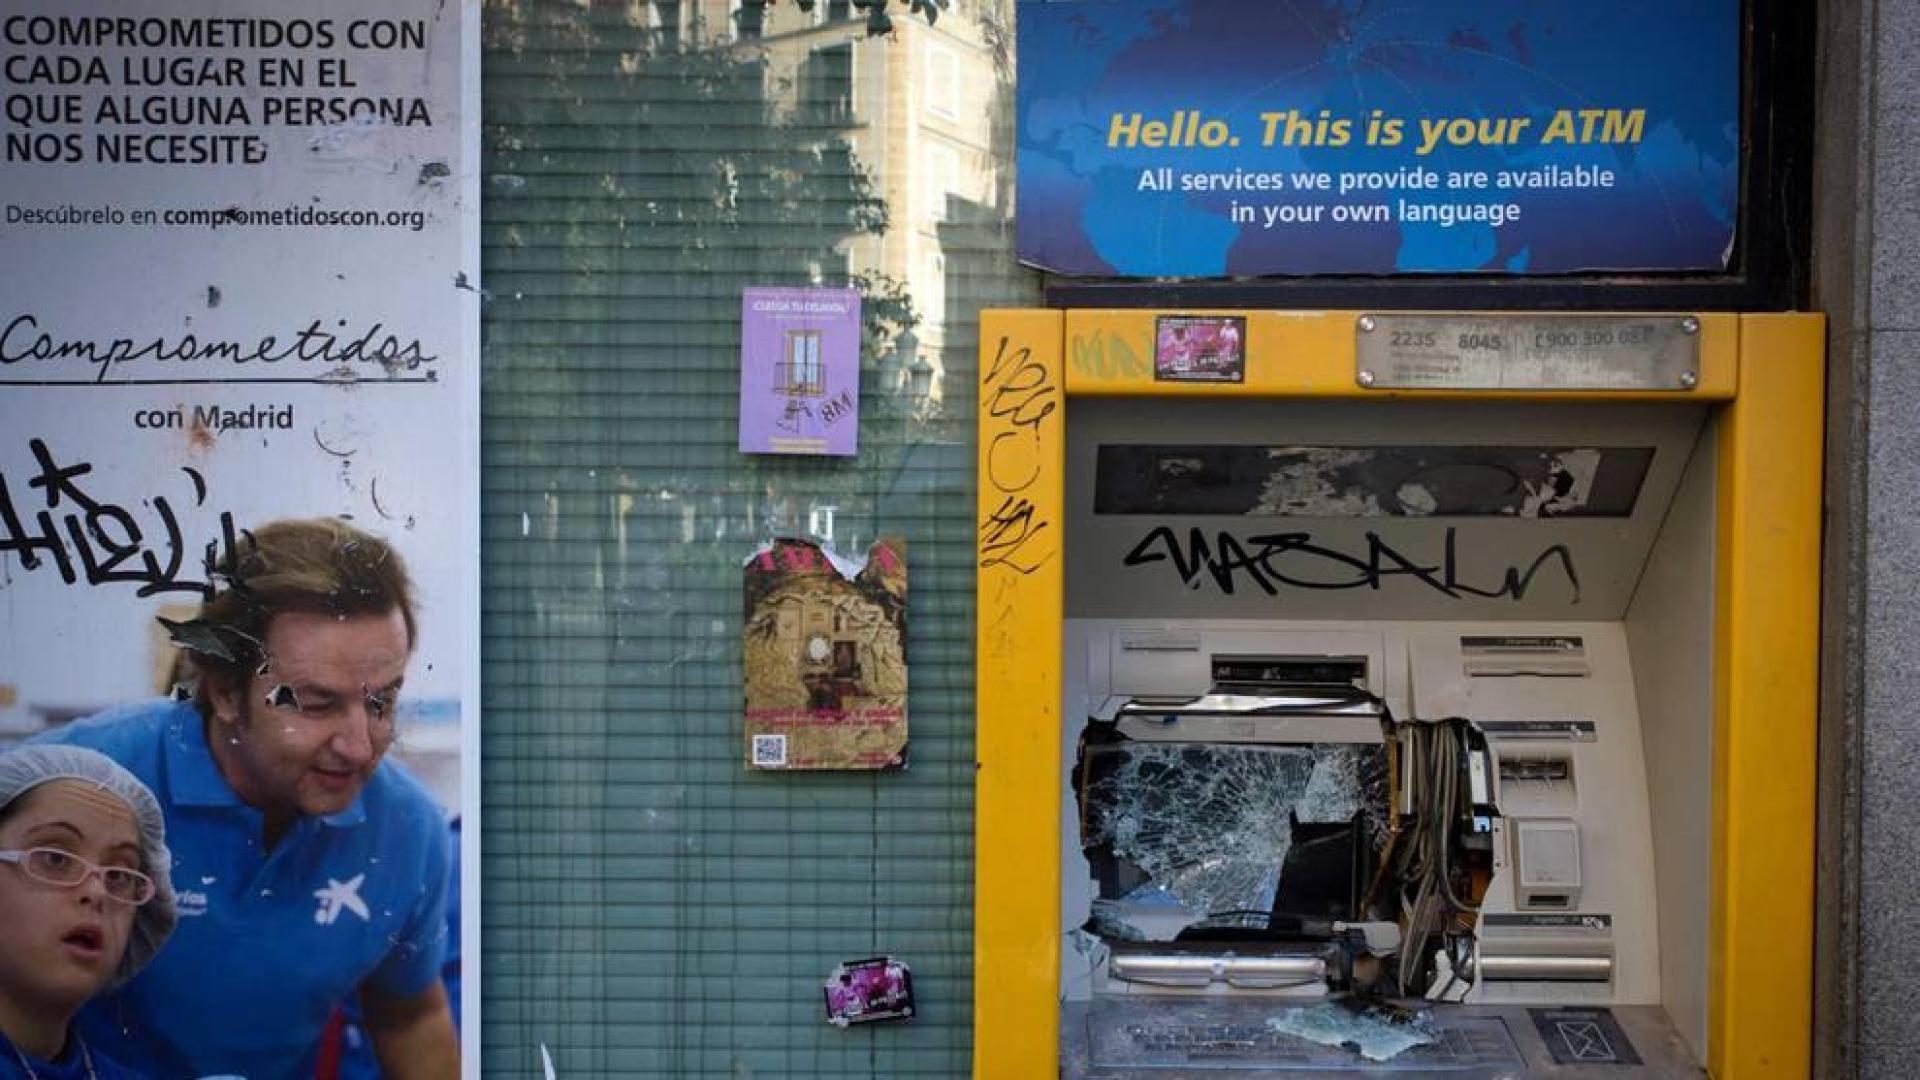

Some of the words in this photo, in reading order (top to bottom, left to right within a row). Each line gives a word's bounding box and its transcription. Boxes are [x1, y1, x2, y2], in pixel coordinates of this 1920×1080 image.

[4, 16, 335, 49] COMPROMETIDOS
[347, 20, 425, 49] CON
[5, 55, 110, 86] CADA
[123, 57, 246, 88] LUGAR
[259, 59, 303, 87] EN
[318, 59, 357, 87] EL
[5, 94, 83, 129] QUE
[95, 95, 251, 126] ALGUNA
[263, 97, 432, 127] PERSONA
[1107, 111, 1241, 148] Hello.
[1260, 110, 1352, 147] This
[1366, 110, 1404, 146] is
[1415, 115, 1530, 155] your
[1541, 109, 1646, 144] ATM
[6, 134, 83, 163] NOS
[97, 136, 268, 164] NECESITE
[1138, 170, 1173, 192] All
[1181, 170, 1283, 191] services
[1292, 174, 1331, 191] we
[1339, 168, 1439, 195] provide
[1447, 171, 1489, 188] are
[1496, 165, 1615, 188] available
[6, 205, 124, 226] Descúbrelo
[131, 210, 156, 225] en
[164, 208, 425, 231] comprometidoscon.org
[1231, 200, 1255, 223] in
[1263, 206, 1324, 229] your
[1332, 204, 1390, 222] own
[1398, 199, 1521, 228] language
[0, 315, 438, 380] Comprometidos
[135, 407, 183, 429] con
[194, 404, 293, 430] Madrid
